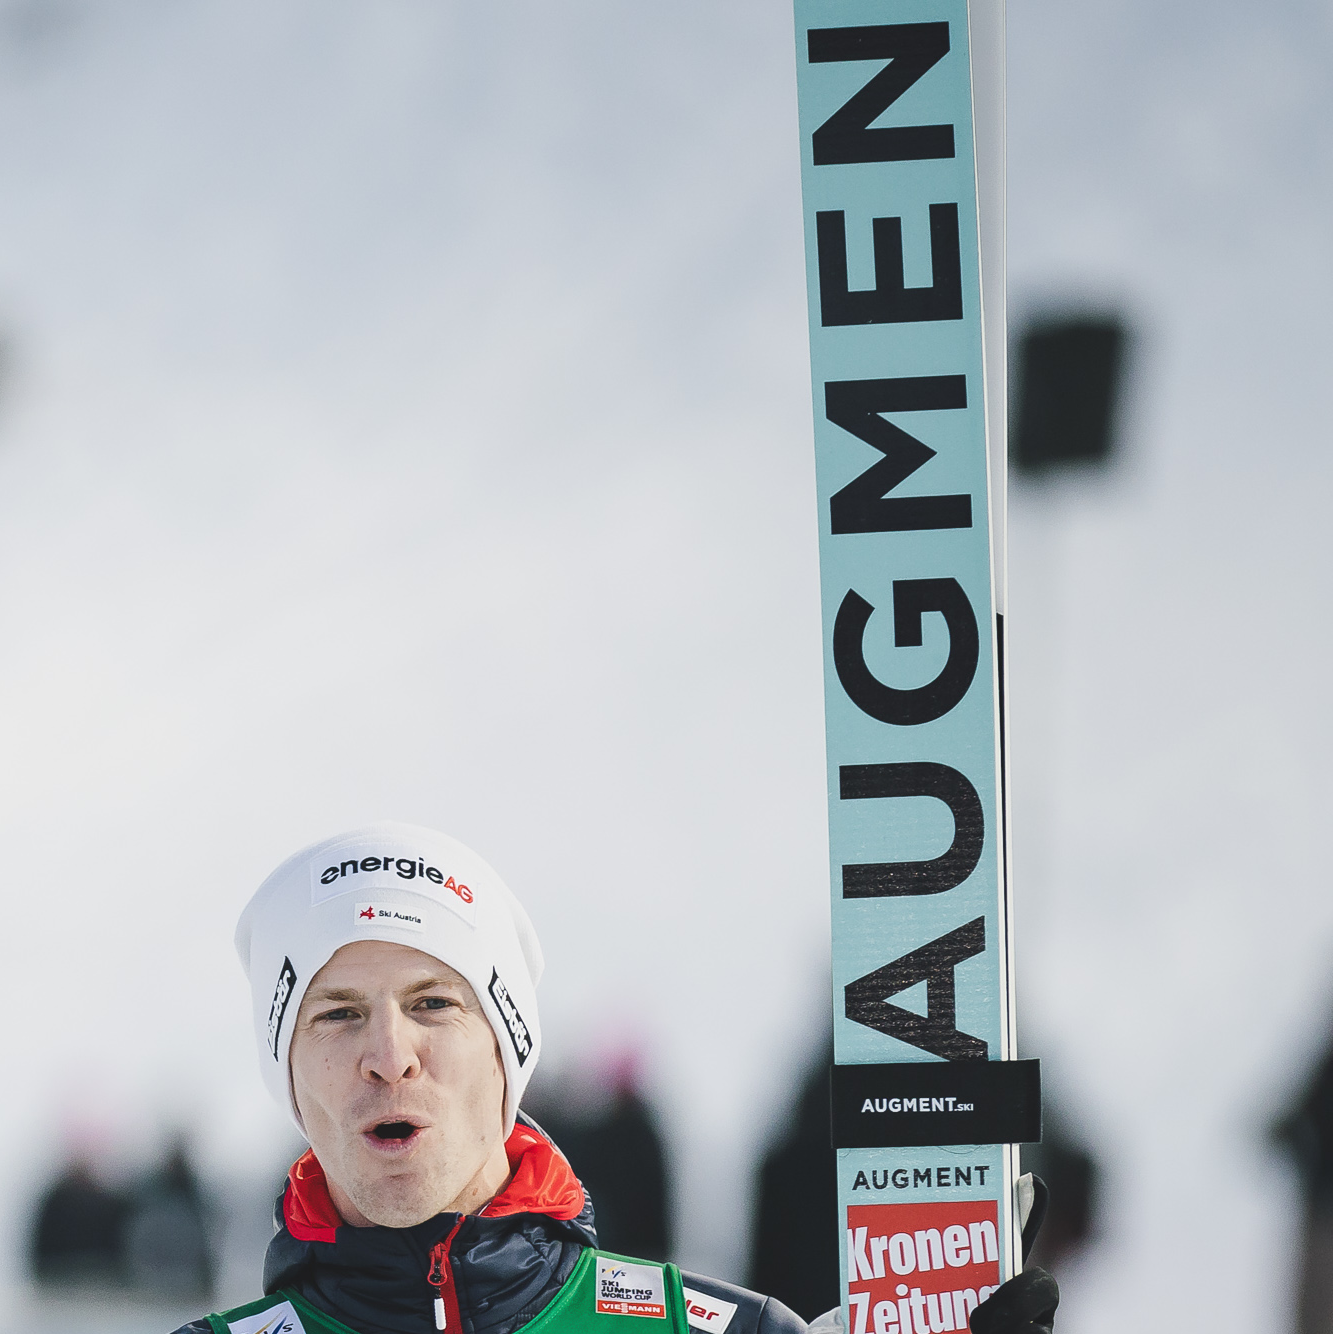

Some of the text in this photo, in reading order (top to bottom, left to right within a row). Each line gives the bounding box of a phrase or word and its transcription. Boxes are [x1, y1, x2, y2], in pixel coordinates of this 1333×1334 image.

[807, 20, 989, 1062] AUGMEN
[378, 909, 422, 924] Ski Austria
[851, 1164, 991, 1191] AUGMENT
[847, 1220, 999, 1282] Kronen
[601, 1279, 619, 1288] SKI
[601, 1286, 653, 1296] JUMPING
[601, 1291, 632, 1300] WORLD
